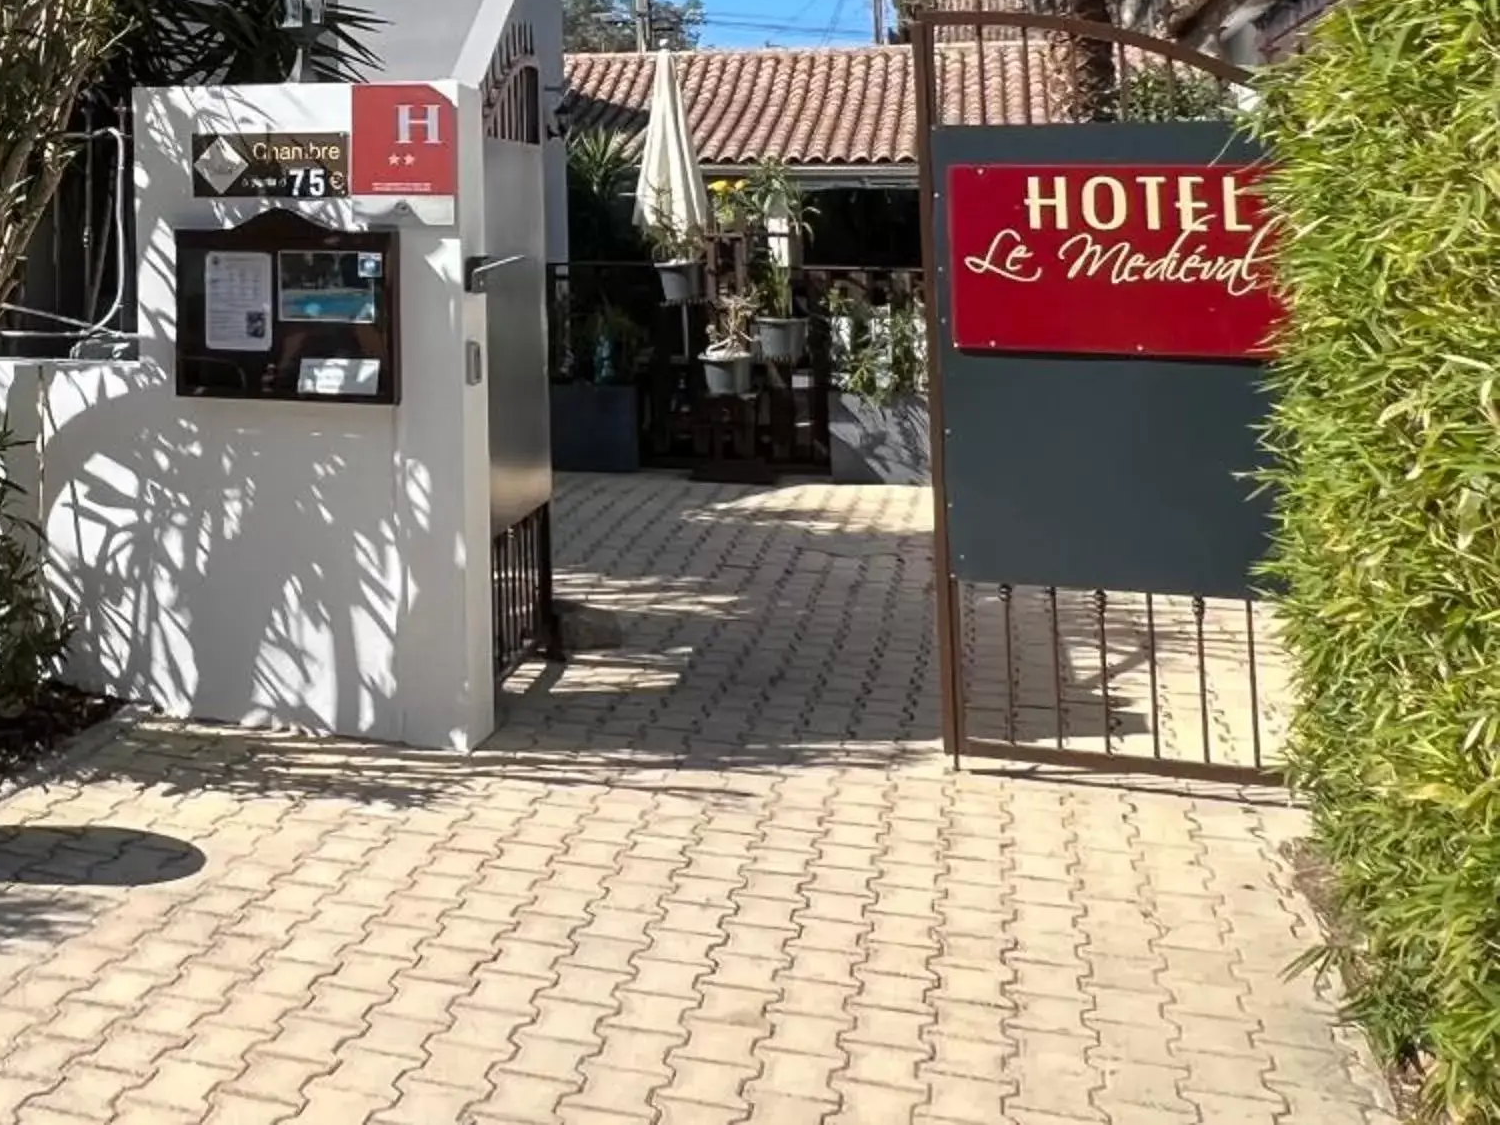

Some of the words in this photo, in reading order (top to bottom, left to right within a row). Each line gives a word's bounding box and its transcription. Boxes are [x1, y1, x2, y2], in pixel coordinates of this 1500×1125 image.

[394, 104, 441, 144] H
[252, 141, 341, 160] Chambre
[289, 168, 325, 196] 75
[1024, 176, 1253, 232] HOTEL
[964, 228, 1043, 282] Le
